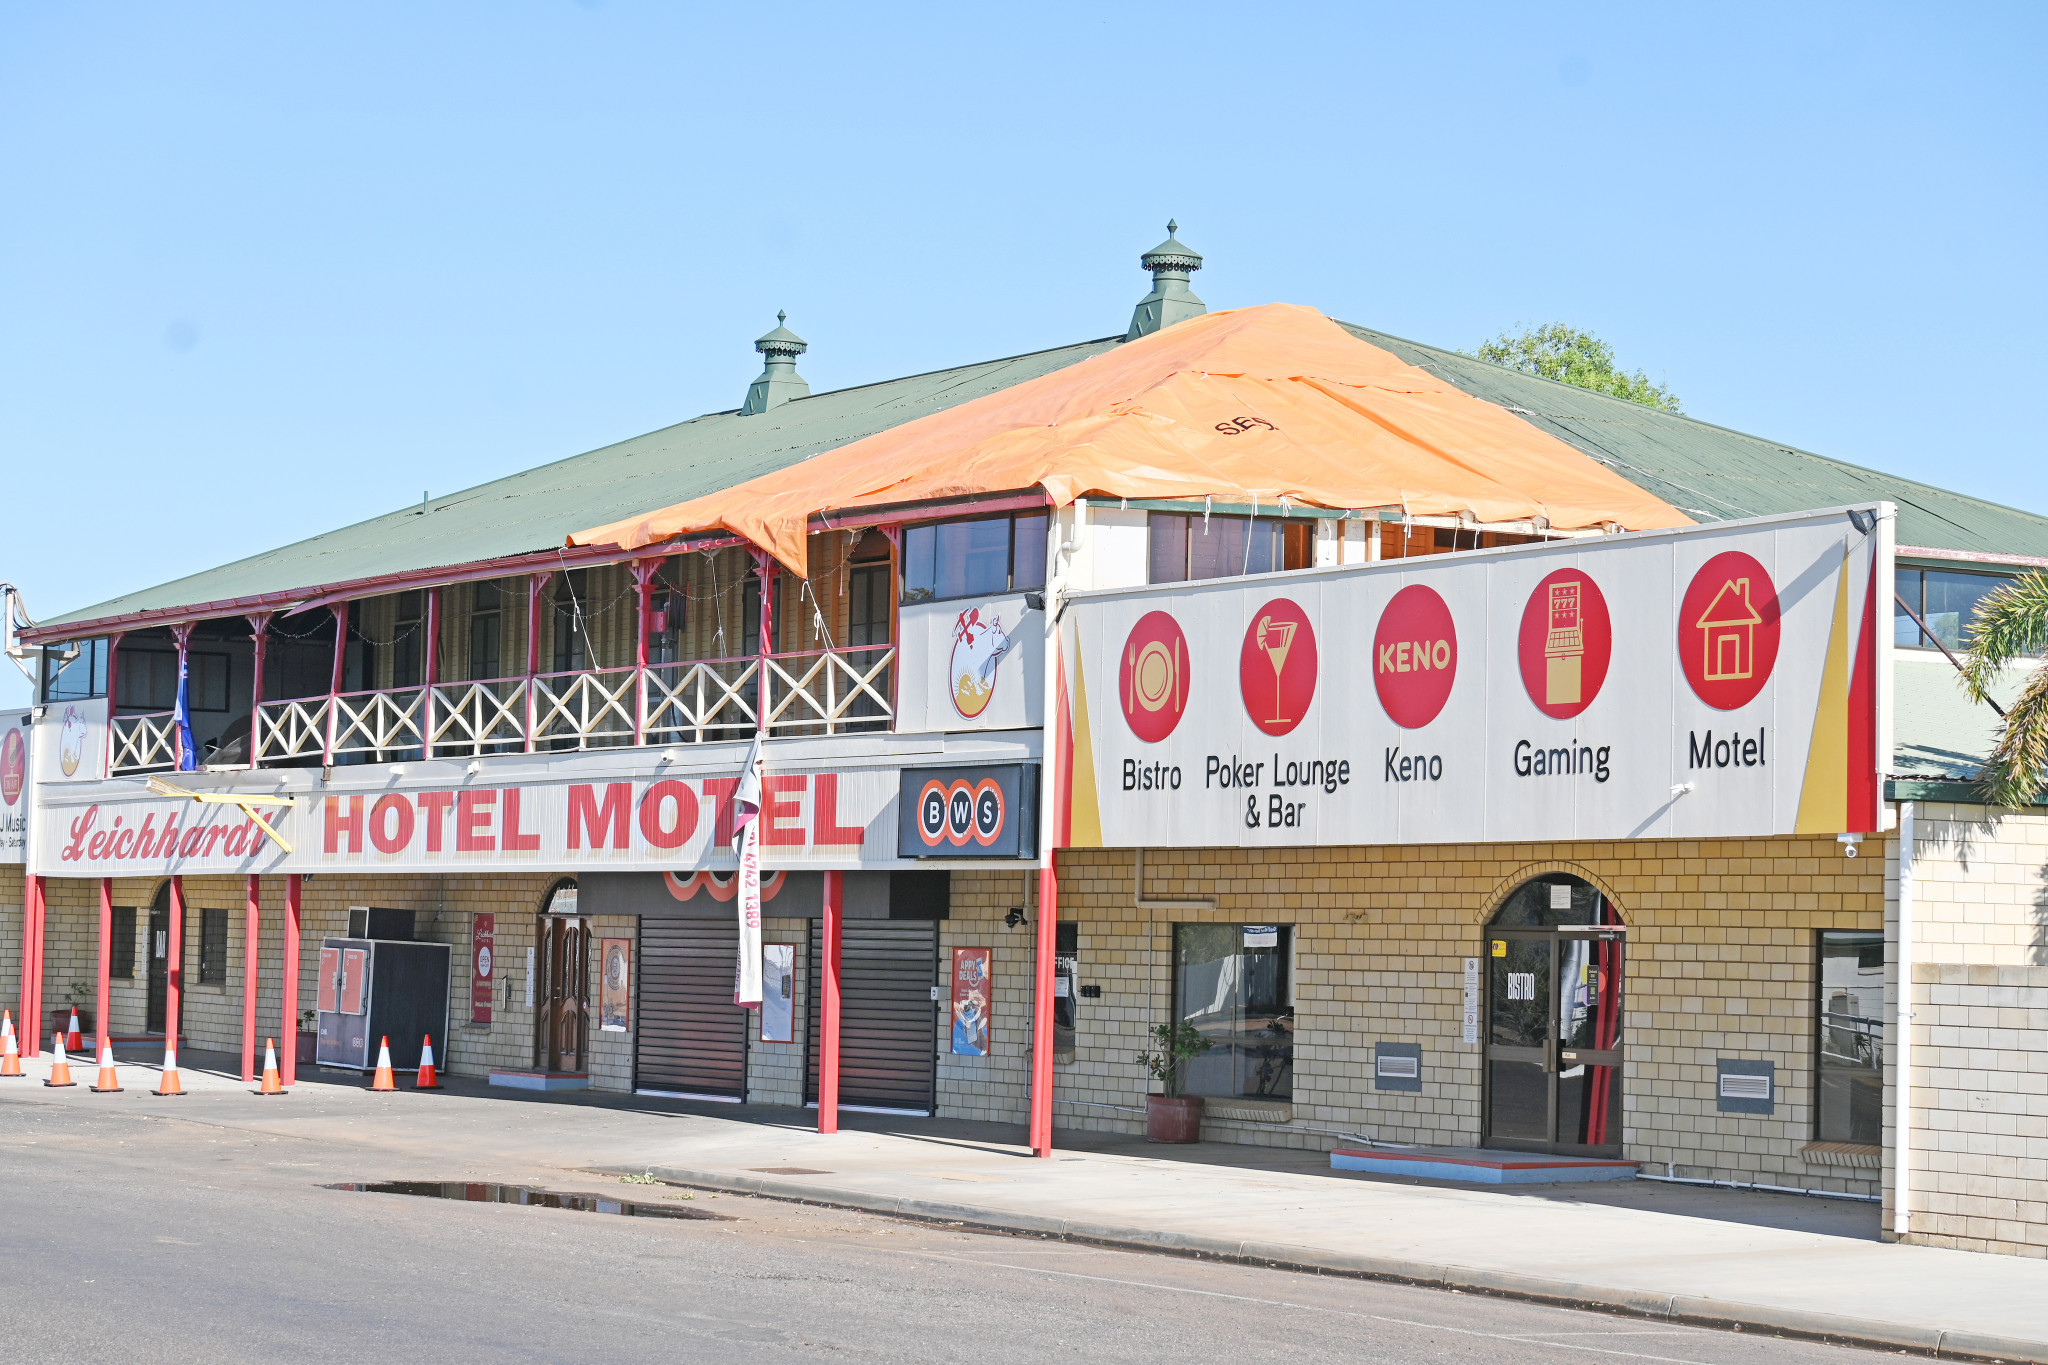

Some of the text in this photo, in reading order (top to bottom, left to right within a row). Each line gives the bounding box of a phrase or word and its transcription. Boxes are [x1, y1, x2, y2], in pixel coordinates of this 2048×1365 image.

[1554, 597, 1575, 610] 777
[1379, 639, 1451, 674] KENO
[1385, 747, 1443, 782] Keno
[1514, 739, 1611, 783] Gaming
[1689, 727, 1766, 769] Motel
[1122, 758, 1182, 791] Bistro
[1206, 753, 1350, 794] Poker Lounge
[6, 814, 26, 832] Music
[324, 773, 865, 854] HOTEL MOTEL
[929, 801, 993, 824] BWS
[1245, 794, 1306, 828] & Bar
[62, 803, 274, 861] Leichhardt
[743, 852, 759, 889] 4742
[745, 893, 760, 929] 1389
[959, 970, 977, 981] DEALS
[961, 960, 976, 970] APPY
[1507, 972, 1535, 1000] BISTRO
